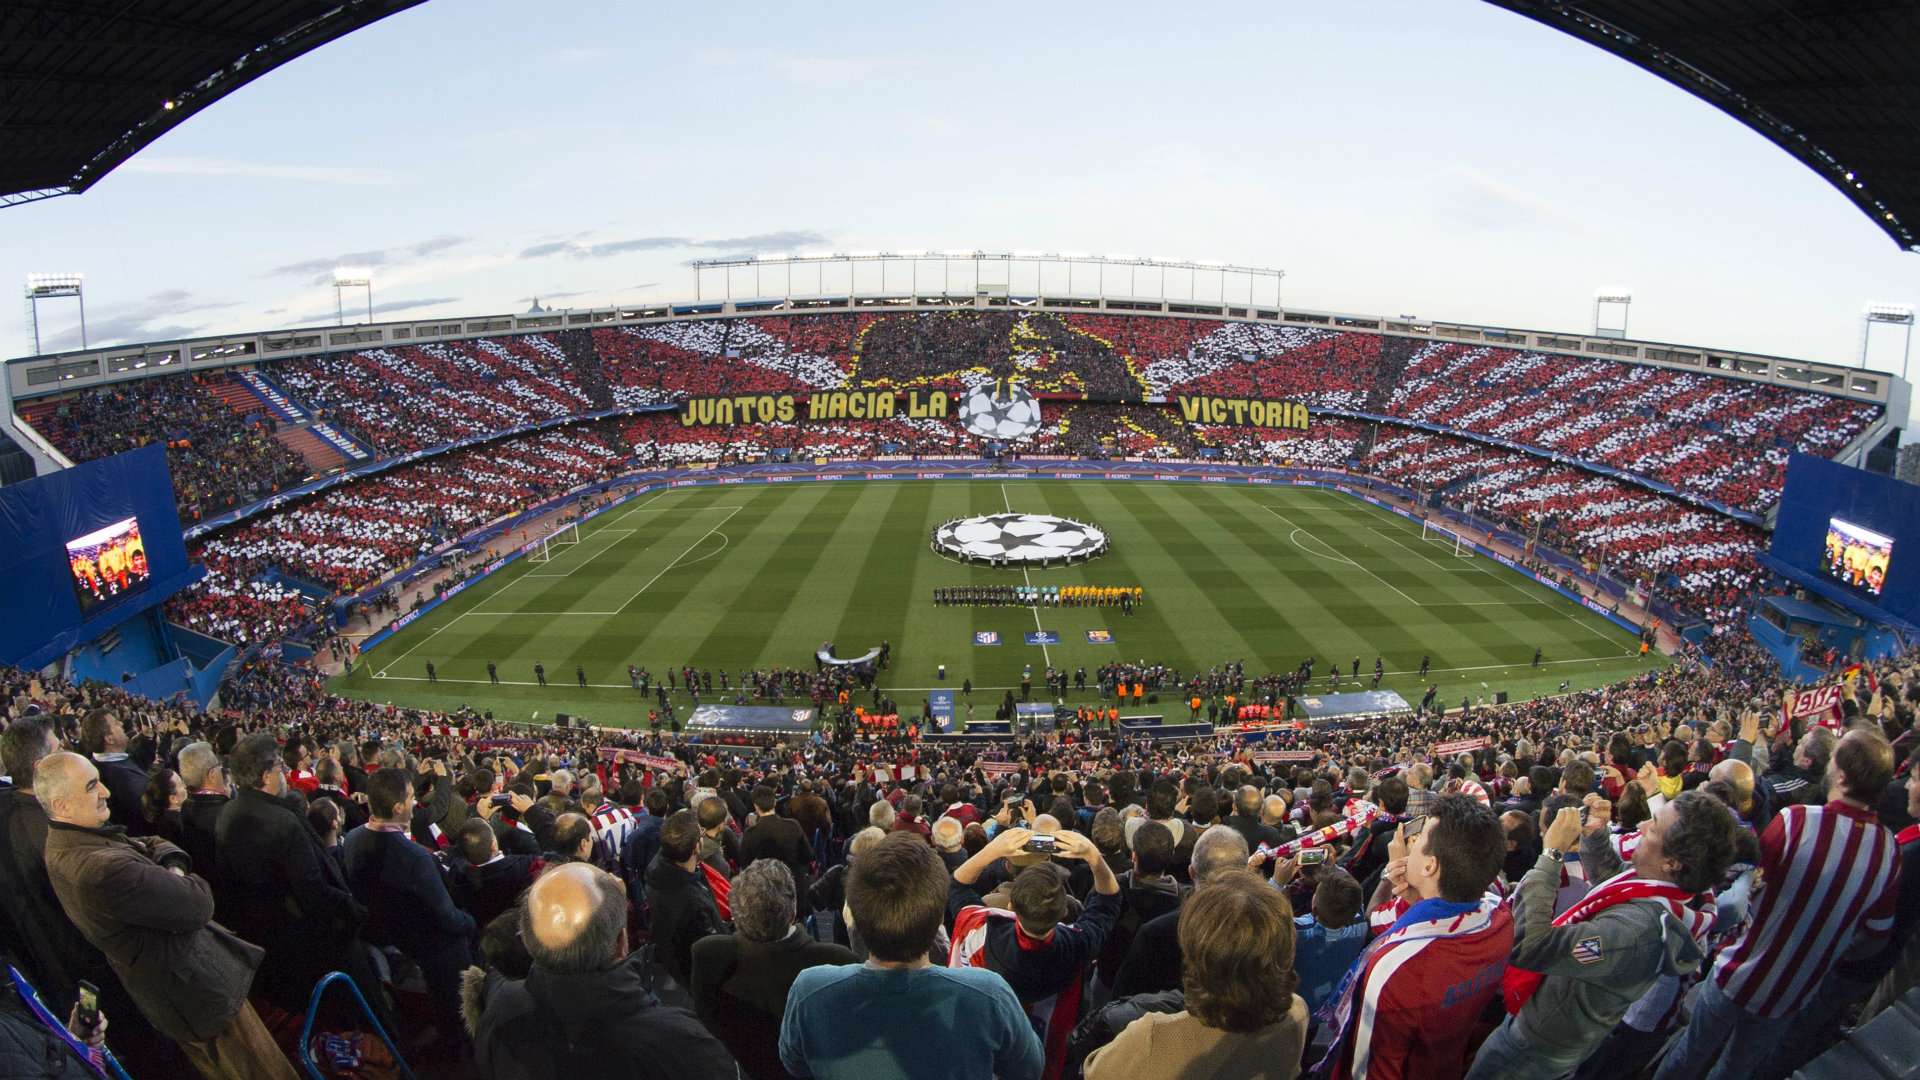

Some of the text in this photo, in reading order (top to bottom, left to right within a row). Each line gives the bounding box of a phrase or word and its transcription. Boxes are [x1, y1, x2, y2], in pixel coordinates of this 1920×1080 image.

[682, 391, 947, 427] JUNTOS HACIA LA
[1178, 395, 1310, 430] VICTORIA
[447, 580, 466, 597] RESPECT
[1541, 575, 1560, 589] RESPECT
[1588, 601, 1610, 616] RESPECT
[398, 609, 420, 626] RESPECT
